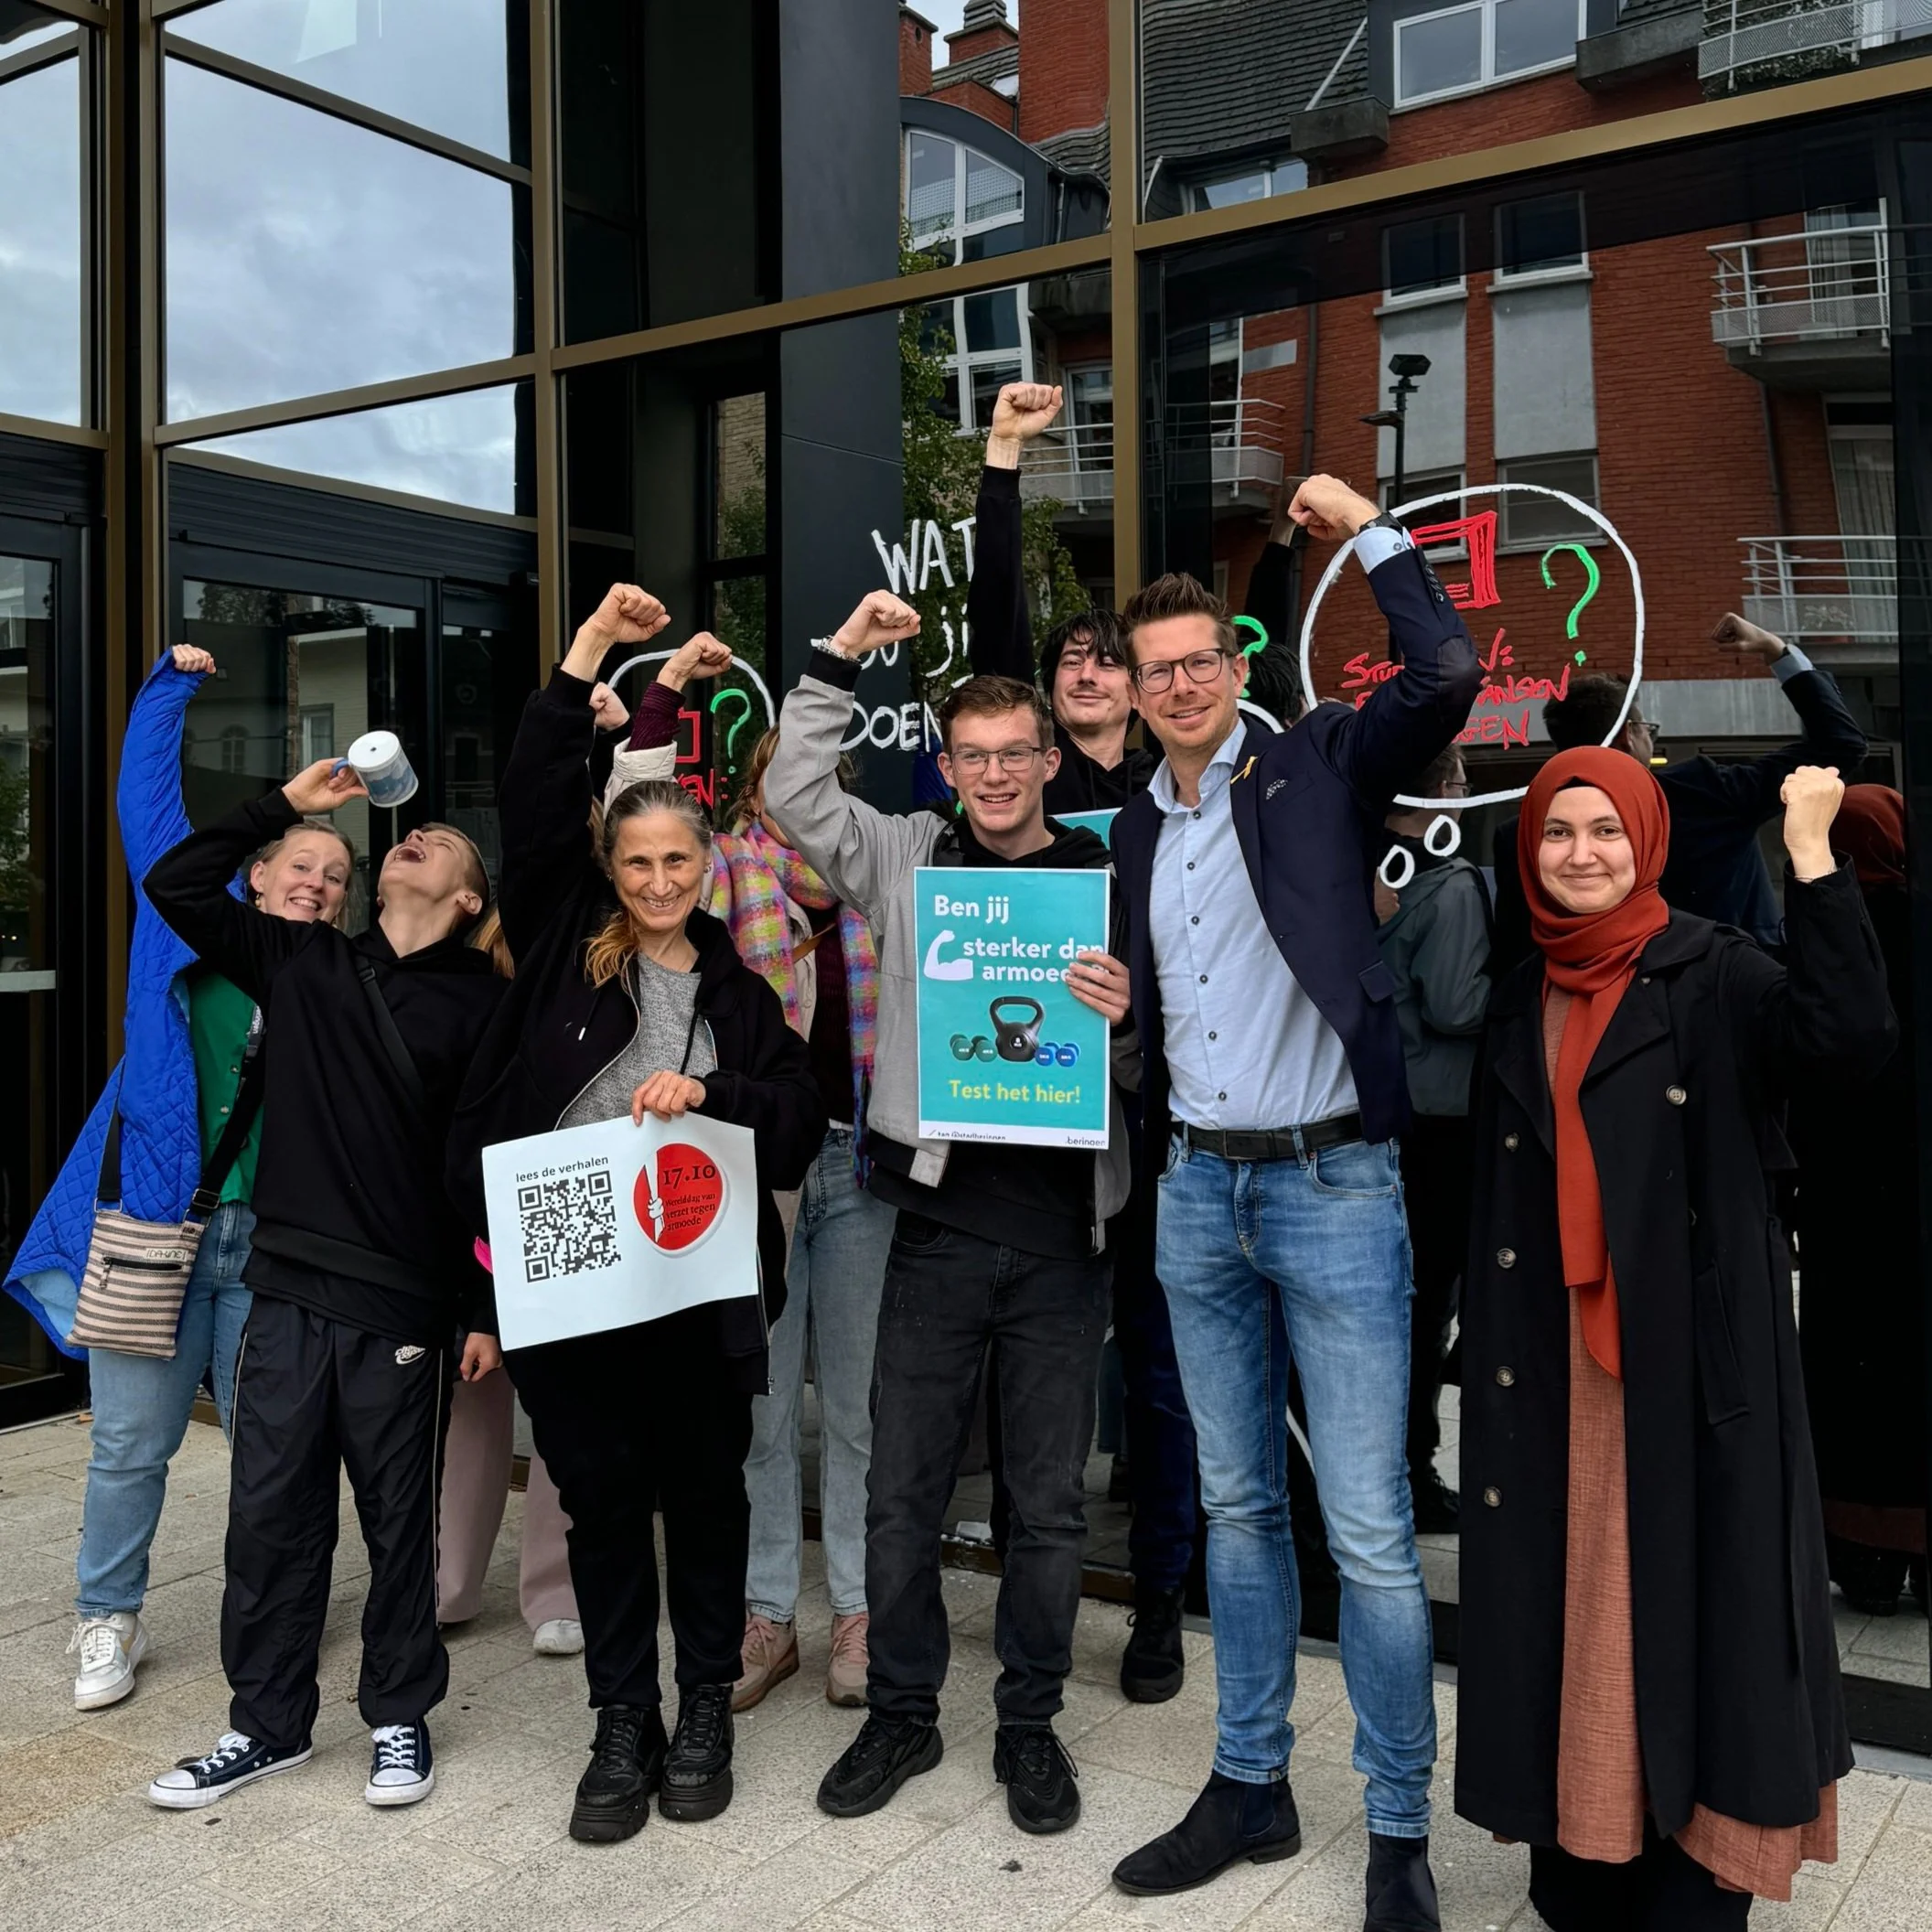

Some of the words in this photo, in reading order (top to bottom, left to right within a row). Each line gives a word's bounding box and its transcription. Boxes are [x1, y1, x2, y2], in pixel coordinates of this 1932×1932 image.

[871, 516, 977, 595] WAT
[934, 894, 981, 918] Ben
[985, 896, 1010, 925] jij
[962, 937, 1052, 959] sterker
[949, 1079, 992, 1100] Test
[996, 1082, 1030, 1101] het
[1036, 1083, 1080, 1104] hier!
[516, 1172, 539, 1183] lees
[542, 1166, 556, 1177] de
[558, 1156, 609, 1174] verhalen
[663, 1165, 716, 1189] 17.10
[666, 1208, 689, 1219] verzet
[690, 1203, 716, 1215] tegen
[667, 1215, 702, 1231] armoede
